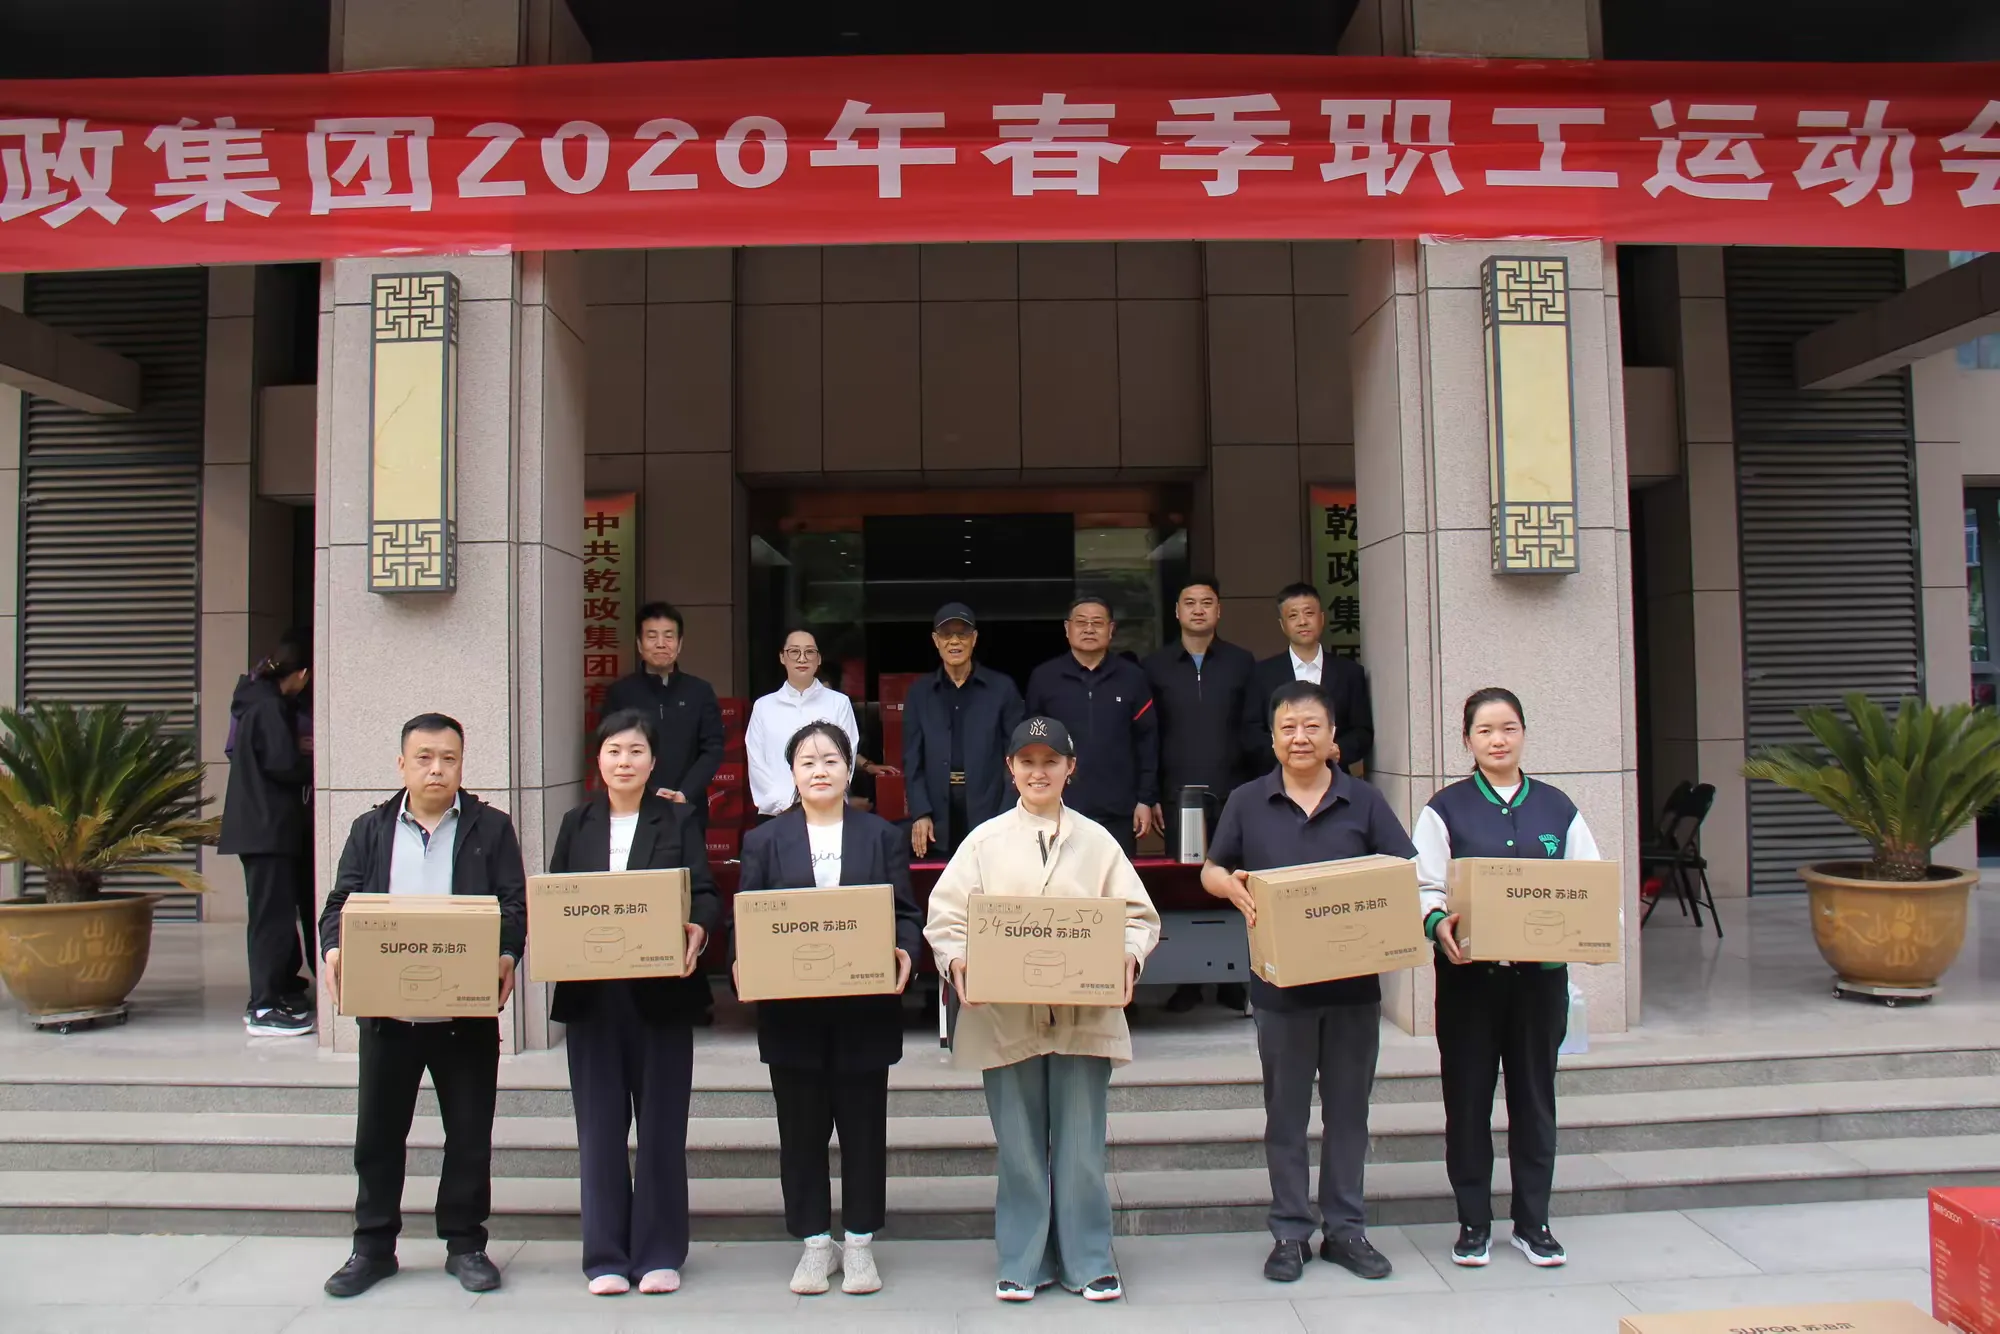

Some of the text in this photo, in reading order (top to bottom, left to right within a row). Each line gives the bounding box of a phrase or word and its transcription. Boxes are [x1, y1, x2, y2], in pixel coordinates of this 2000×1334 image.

[1506, 887, 1588, 900] SUPOR 苏泊尔
[563, 903, 648, 917] SUPOR 苏泊尔
[1305, 897, 1388, 919] SUPOR 苏泊尔
[772, 919, 858, 934] SUPOR 苏泊尔
[1004, 925, 1091, 939] SUPOR 苏泊尔
[380, 942, 467, 954] SUPOR 苏泊尔
